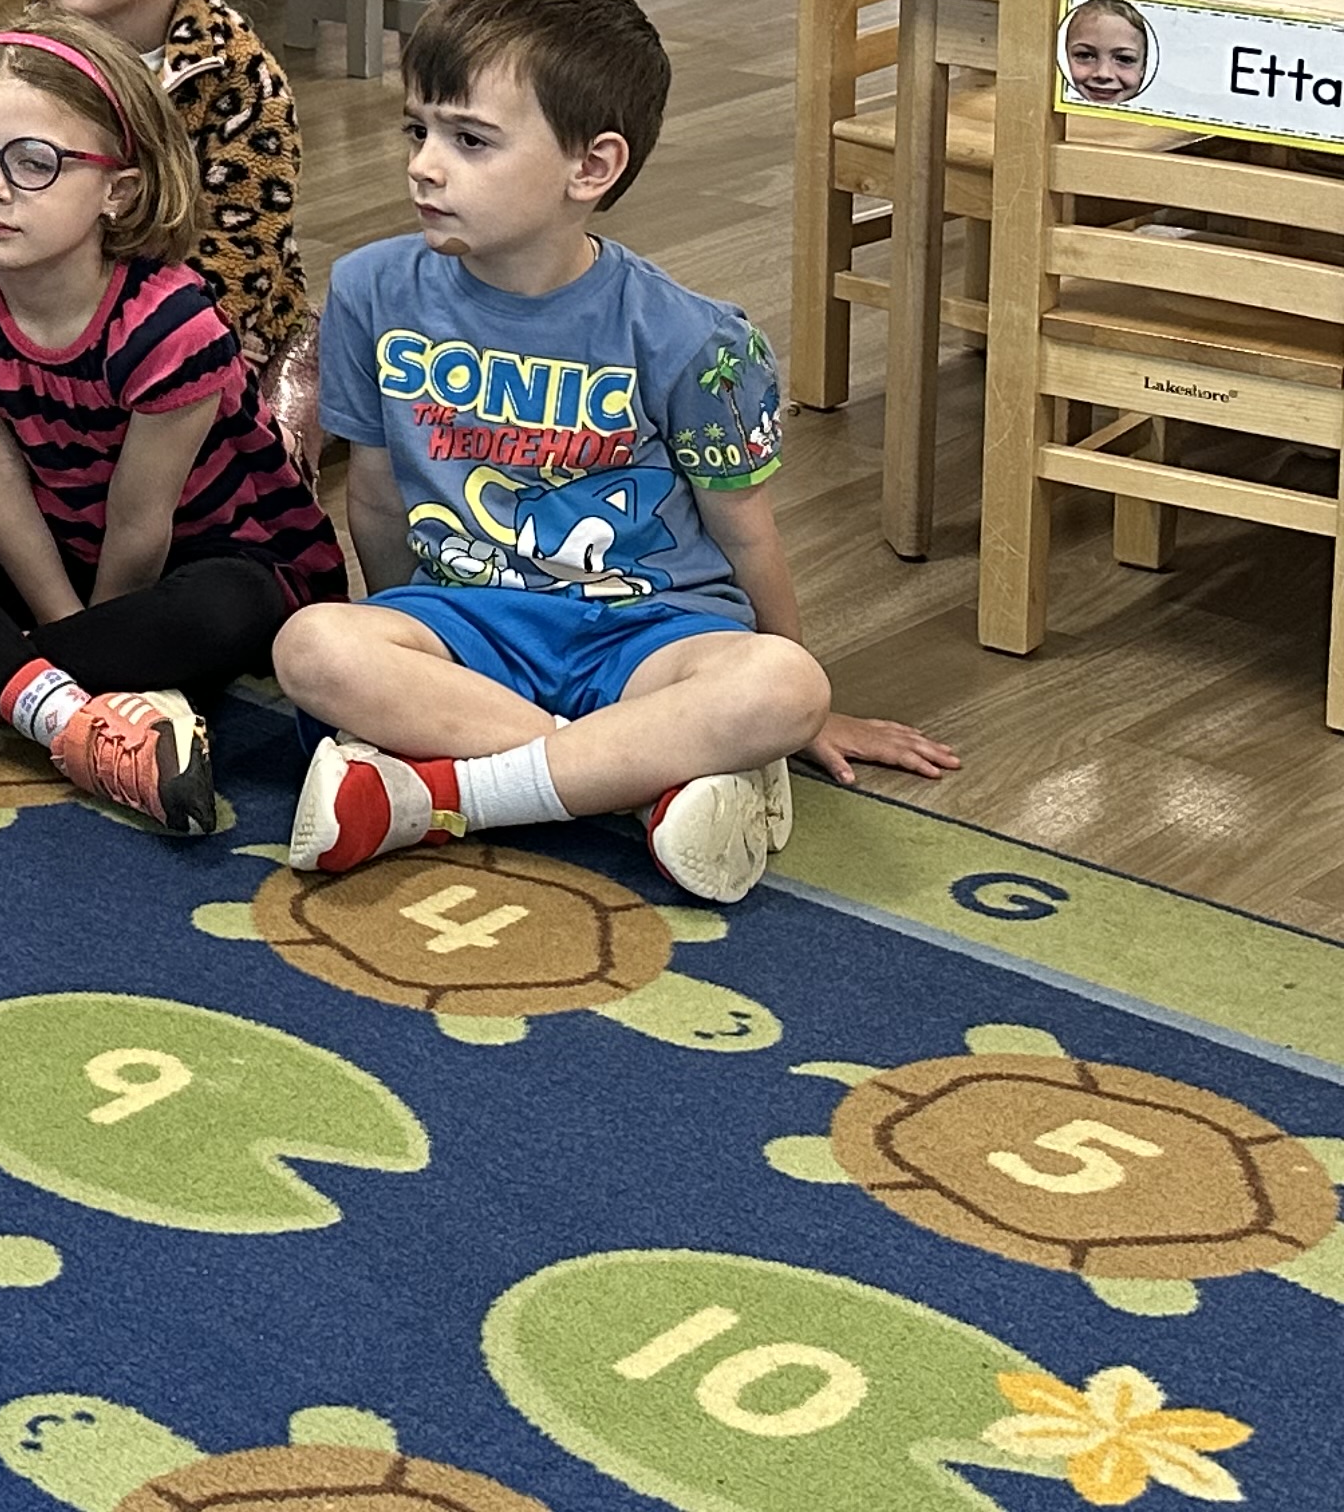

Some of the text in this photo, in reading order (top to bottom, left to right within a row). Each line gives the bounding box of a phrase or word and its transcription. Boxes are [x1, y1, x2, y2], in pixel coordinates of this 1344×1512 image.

[1230, 45, 1342, 108] Etta
[376, 328, 638, 436] SONIC
[1144, 375, 1230, 406] Lakeshore
[412, 403, 458, 429] THE
[428, 424, 638, 469] HEDGEHOG
[399, 883, 529, 954] 4
[948, 871, 1072, 922] G
[83, 1046, 194, 1125] 9
[987, 1118, 1164, 1194] 5
[611, 1303, 870, 1437] 10
